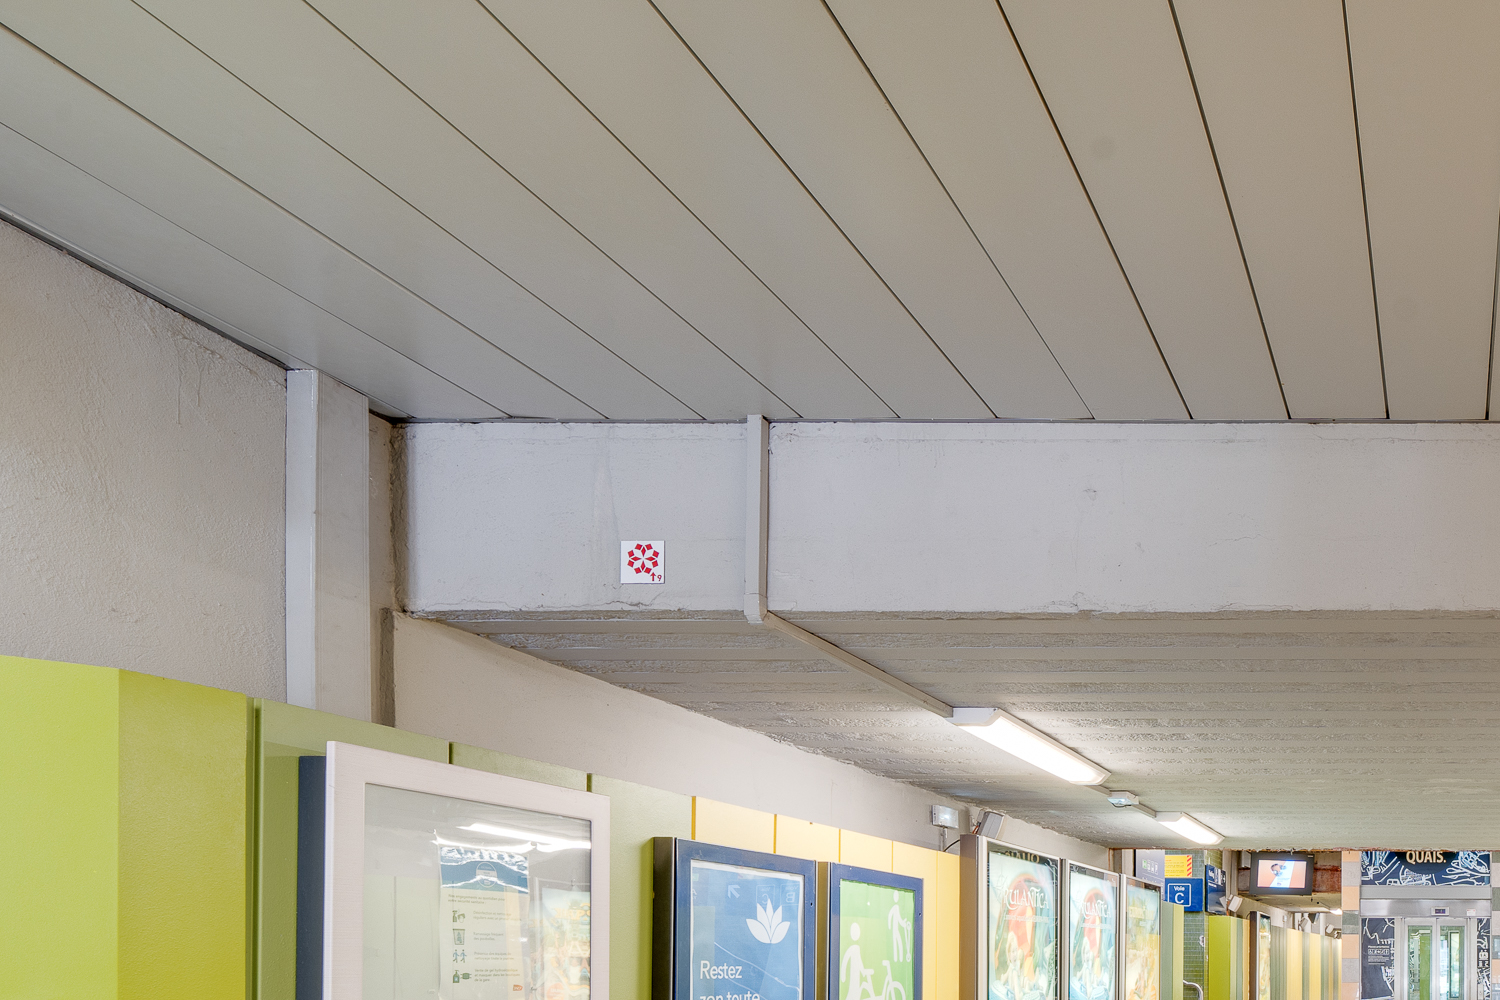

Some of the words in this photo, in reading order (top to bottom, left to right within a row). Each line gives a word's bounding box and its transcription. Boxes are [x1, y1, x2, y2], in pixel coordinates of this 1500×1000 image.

[1406, 851, 1447, 865] QUAIS.
[1175, 892, 1185, 904] C
[700, 960, 742, 980] Restez
